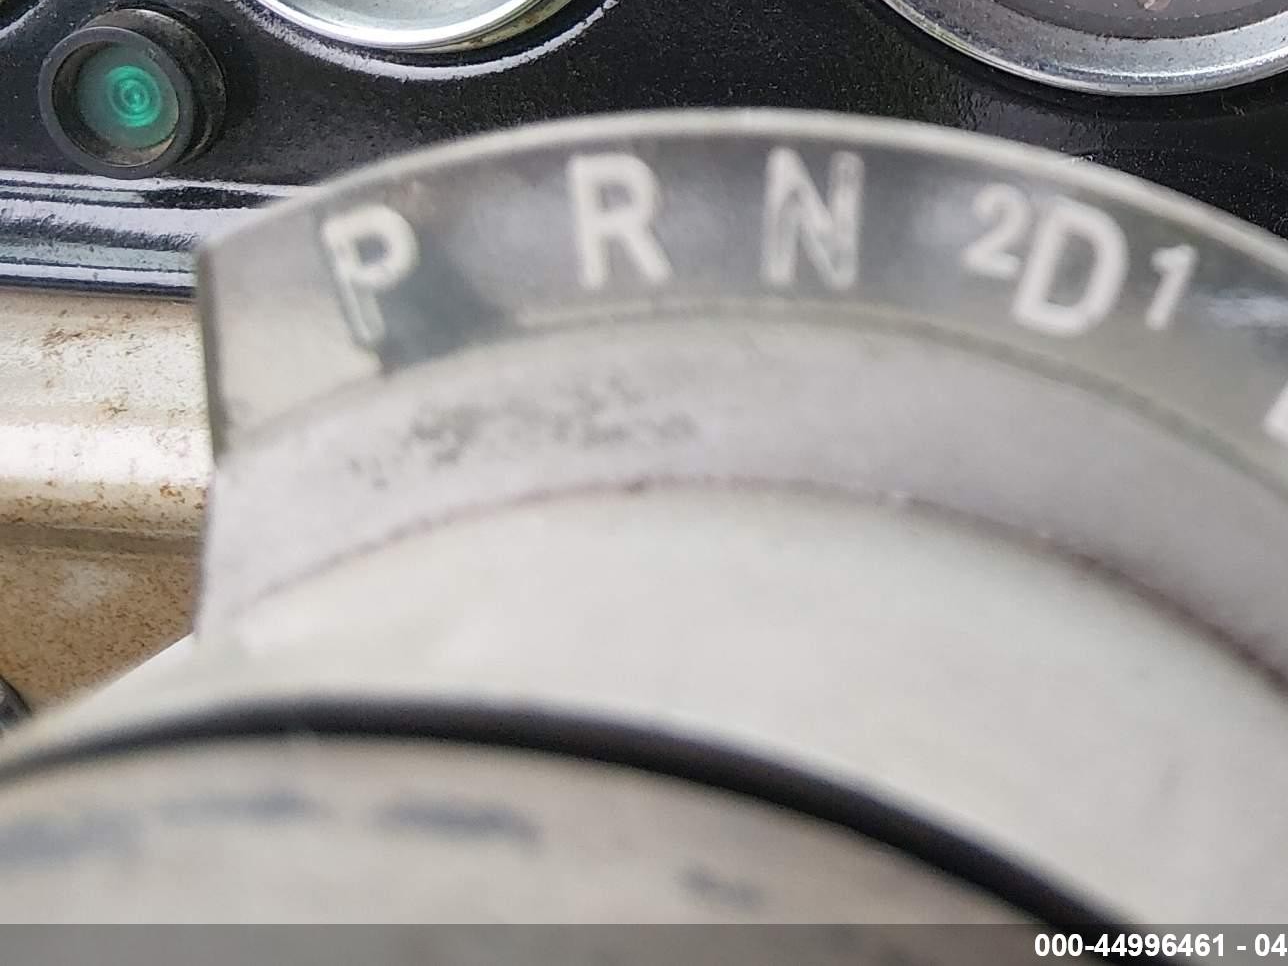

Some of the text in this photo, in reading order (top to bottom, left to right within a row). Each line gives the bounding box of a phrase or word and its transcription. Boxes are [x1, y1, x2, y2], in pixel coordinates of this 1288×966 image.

[322, 202, 420, 344] P
[566, 151, 673, 289] R
[759, 146, 865, 289] N
